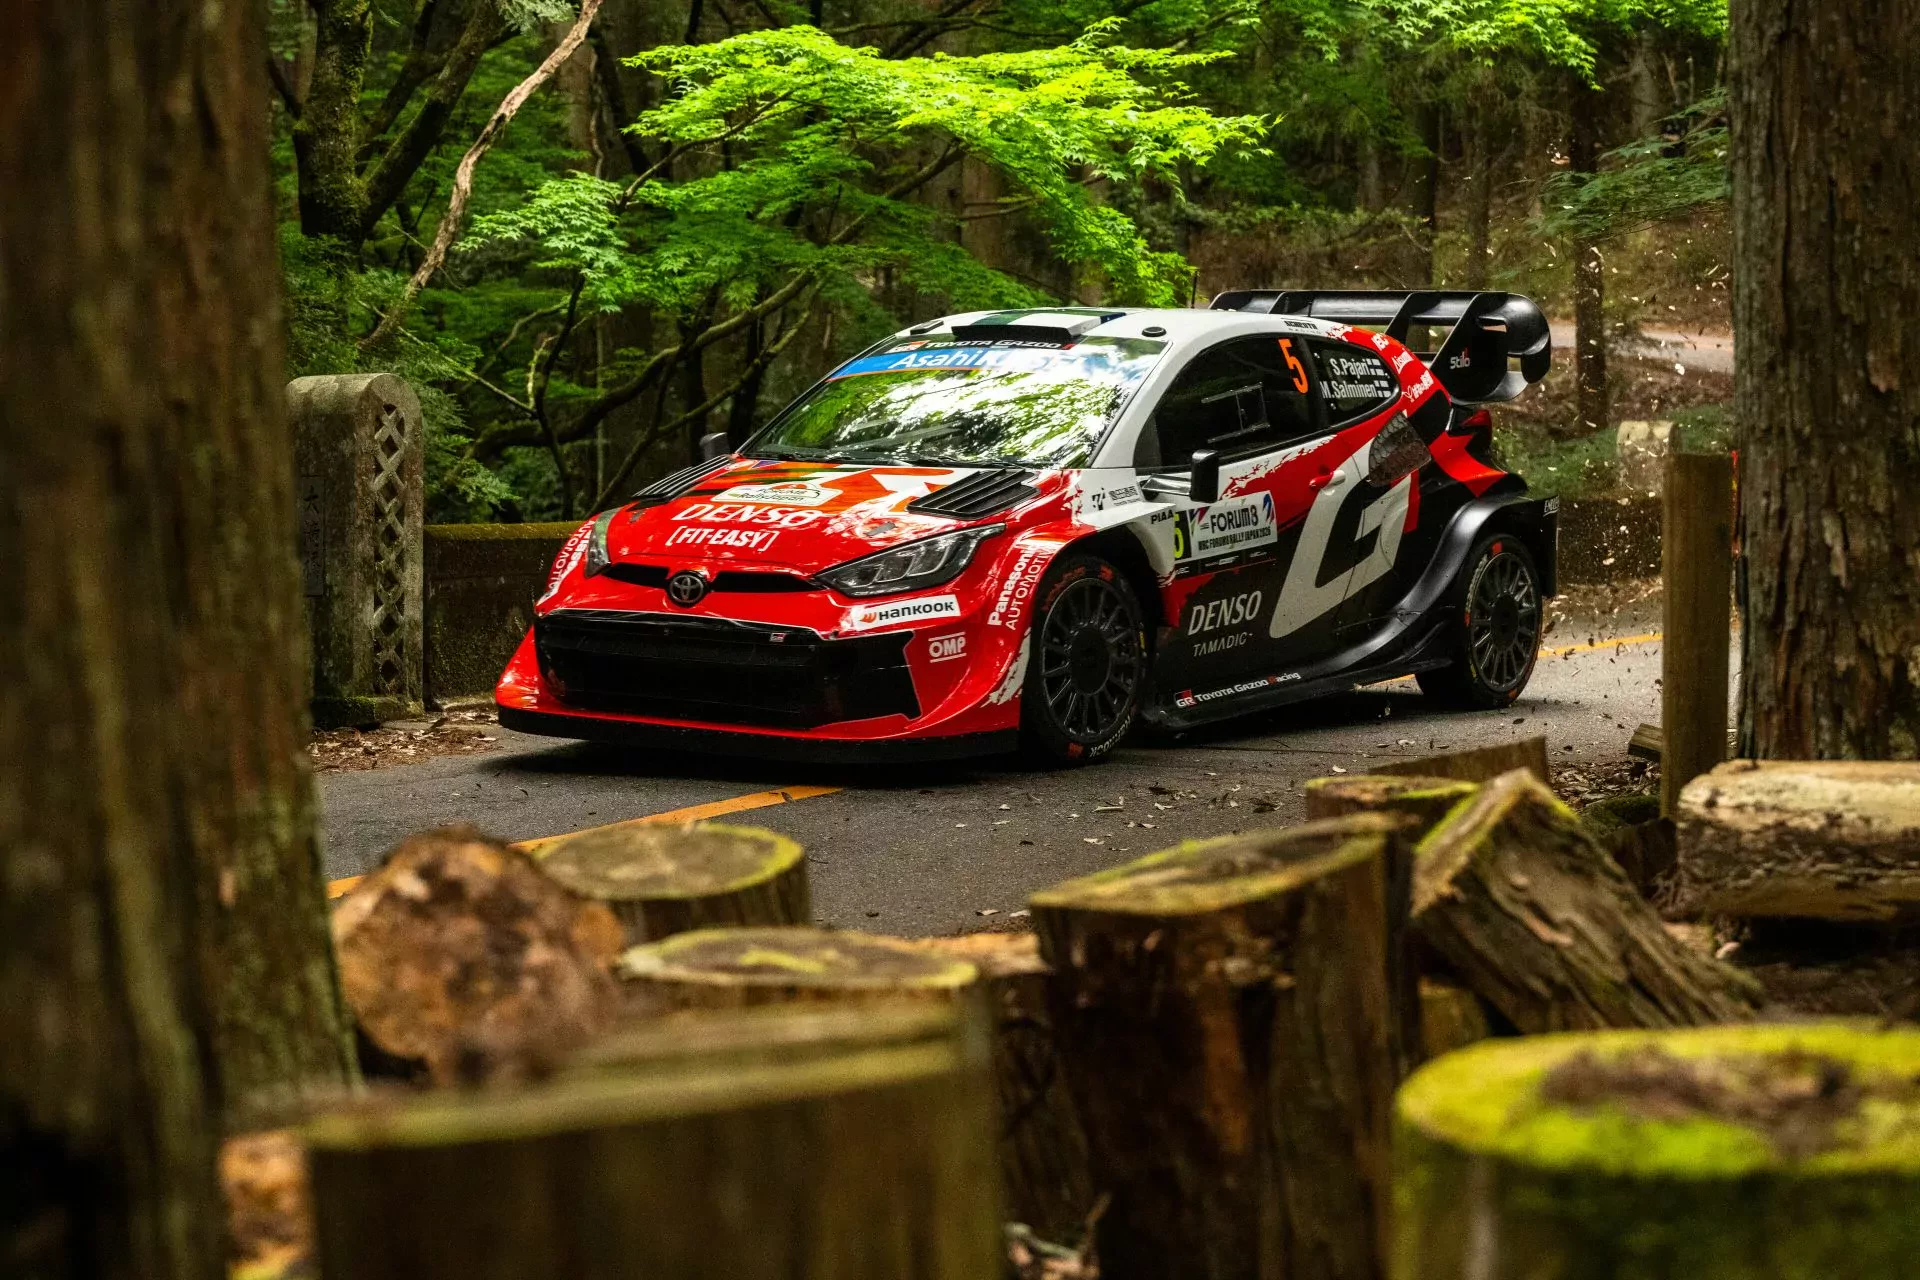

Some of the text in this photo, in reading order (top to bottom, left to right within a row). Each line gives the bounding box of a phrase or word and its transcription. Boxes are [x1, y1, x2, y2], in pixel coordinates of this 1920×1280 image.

[925, 340, 993, 349] TOYOTA
[994, 339, 1061, 349] GAZOO
[1278, 338, 1309, 394] 5
[1329, 357, 1370, 379] S.Pajari
[1320, 379, 1378, 399] M.Salminen
[671, 503, 823, 527] DENSO
[1150, 510, 1174, 525] PIAA
[1210, 505, 1259, 534] FORUM8
[987, 545, 1035, 626] Panasoni
[1005, 549, 1055, 630] AUTOMOTIV
[1187, 590, 1262, 636] DENSO
[928, 636, 967, 658] OMP
[1193, 631, 1248, 657] TAMADIC
[1175, 696, 1197, 708] GR
[1194, 687, 1235, 702] TOYOTA
[1234, 679, 1269, 692] GAZOO
